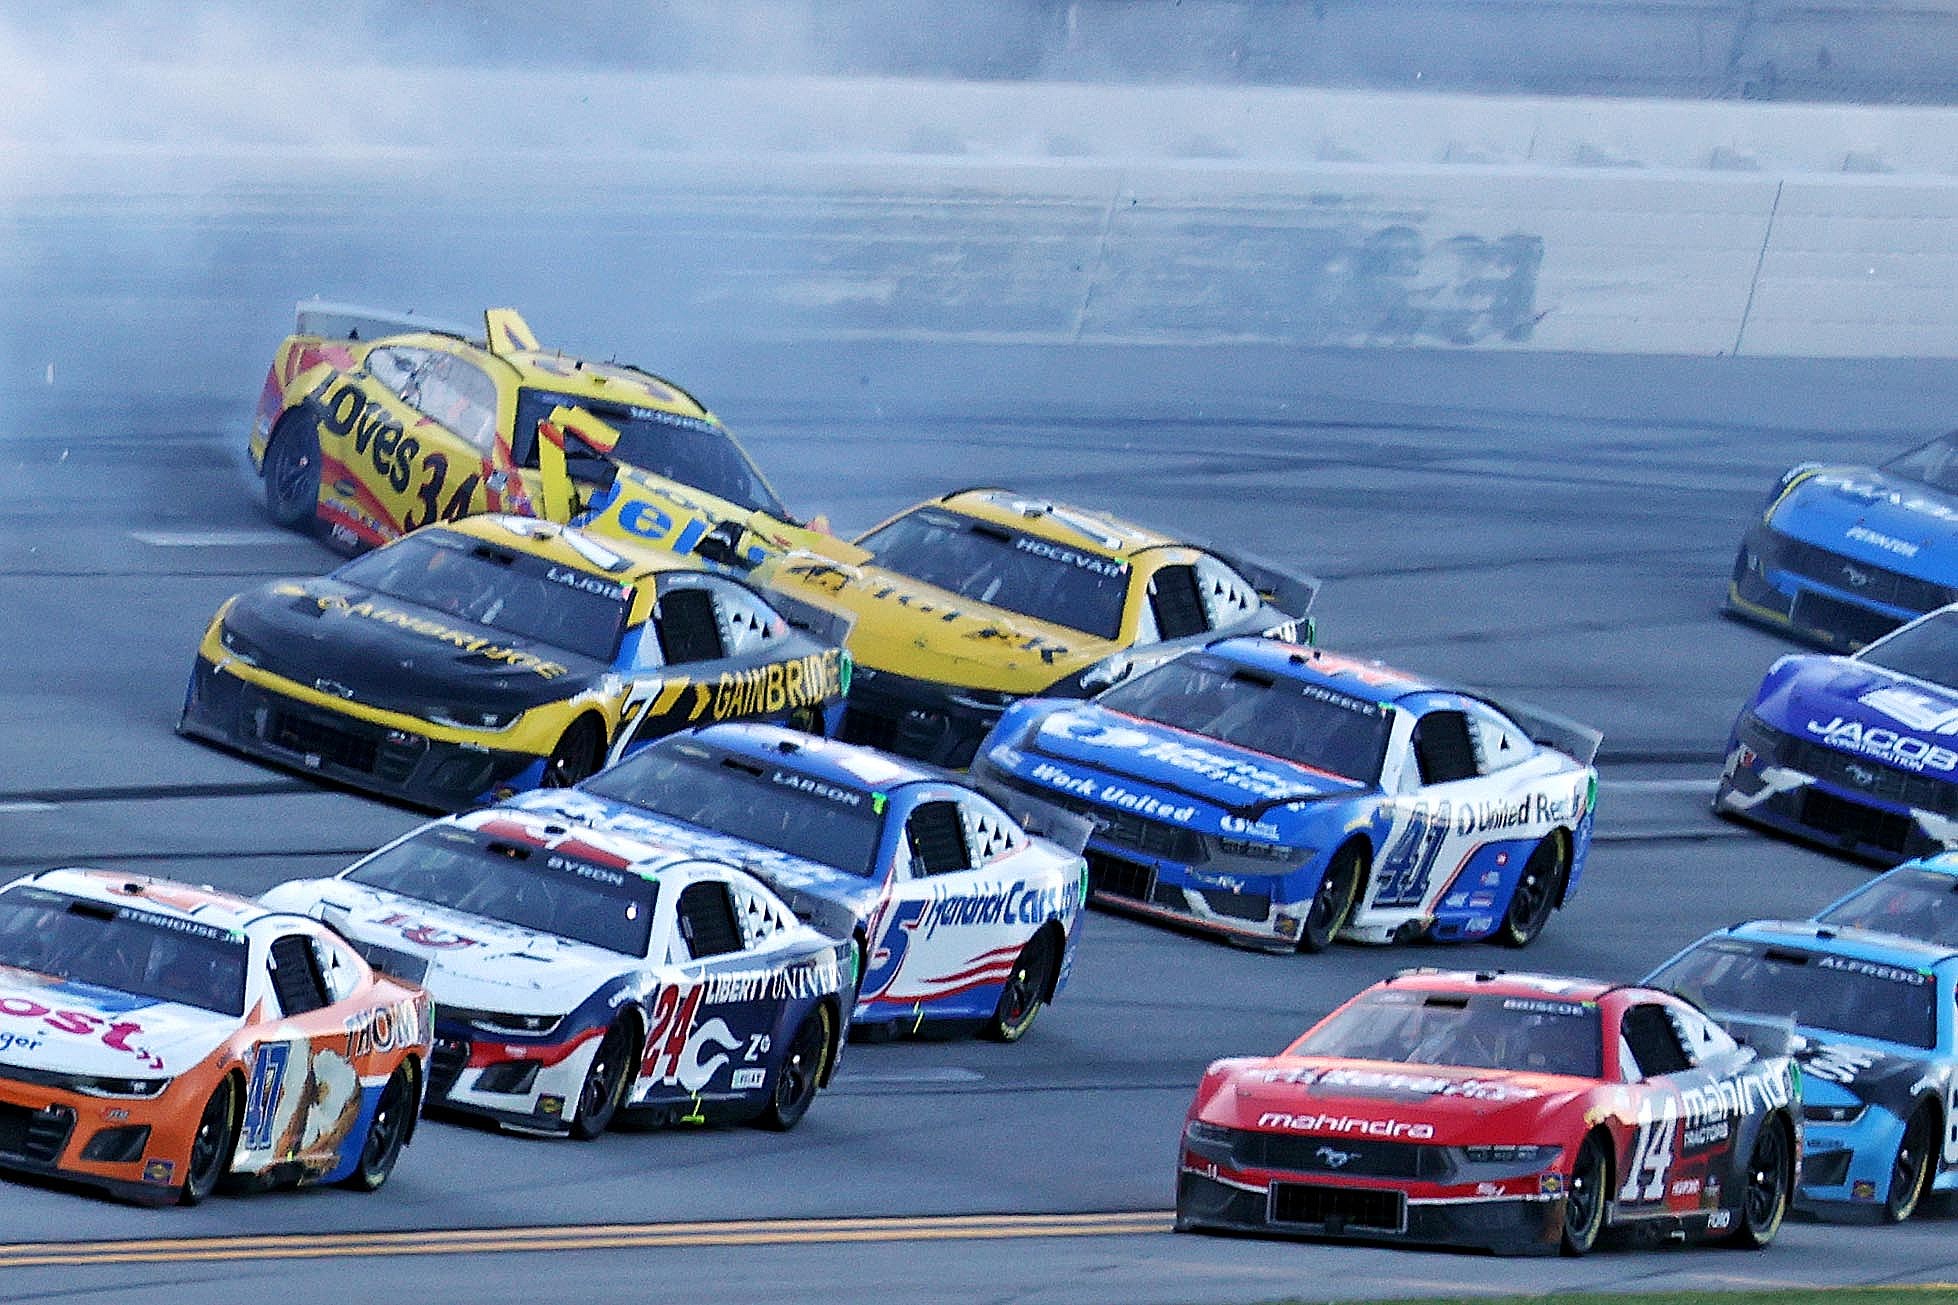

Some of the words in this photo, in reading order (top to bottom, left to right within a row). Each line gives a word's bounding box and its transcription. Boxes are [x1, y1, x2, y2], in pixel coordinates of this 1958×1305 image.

[600, 679, 664, 768] 7
[772, 772, 862, 808] LARSON
[1032, 763, 1098, 797] Work
[1100, 786, 1197, 823] United
[1478, 793, 1532, 832] United
[546, 857, 626, 886] BYRON
[857, 898, 930, 1002] 5
[704, 968, 771, 1005] LIBERTY
[1817, 955, 1927, 986] ALFREDO
[641, 983, 706, 1085] 24
[1258, 1112, 1434, 1140] mahindra
[1620, 1094, 1678, 1201] 14
